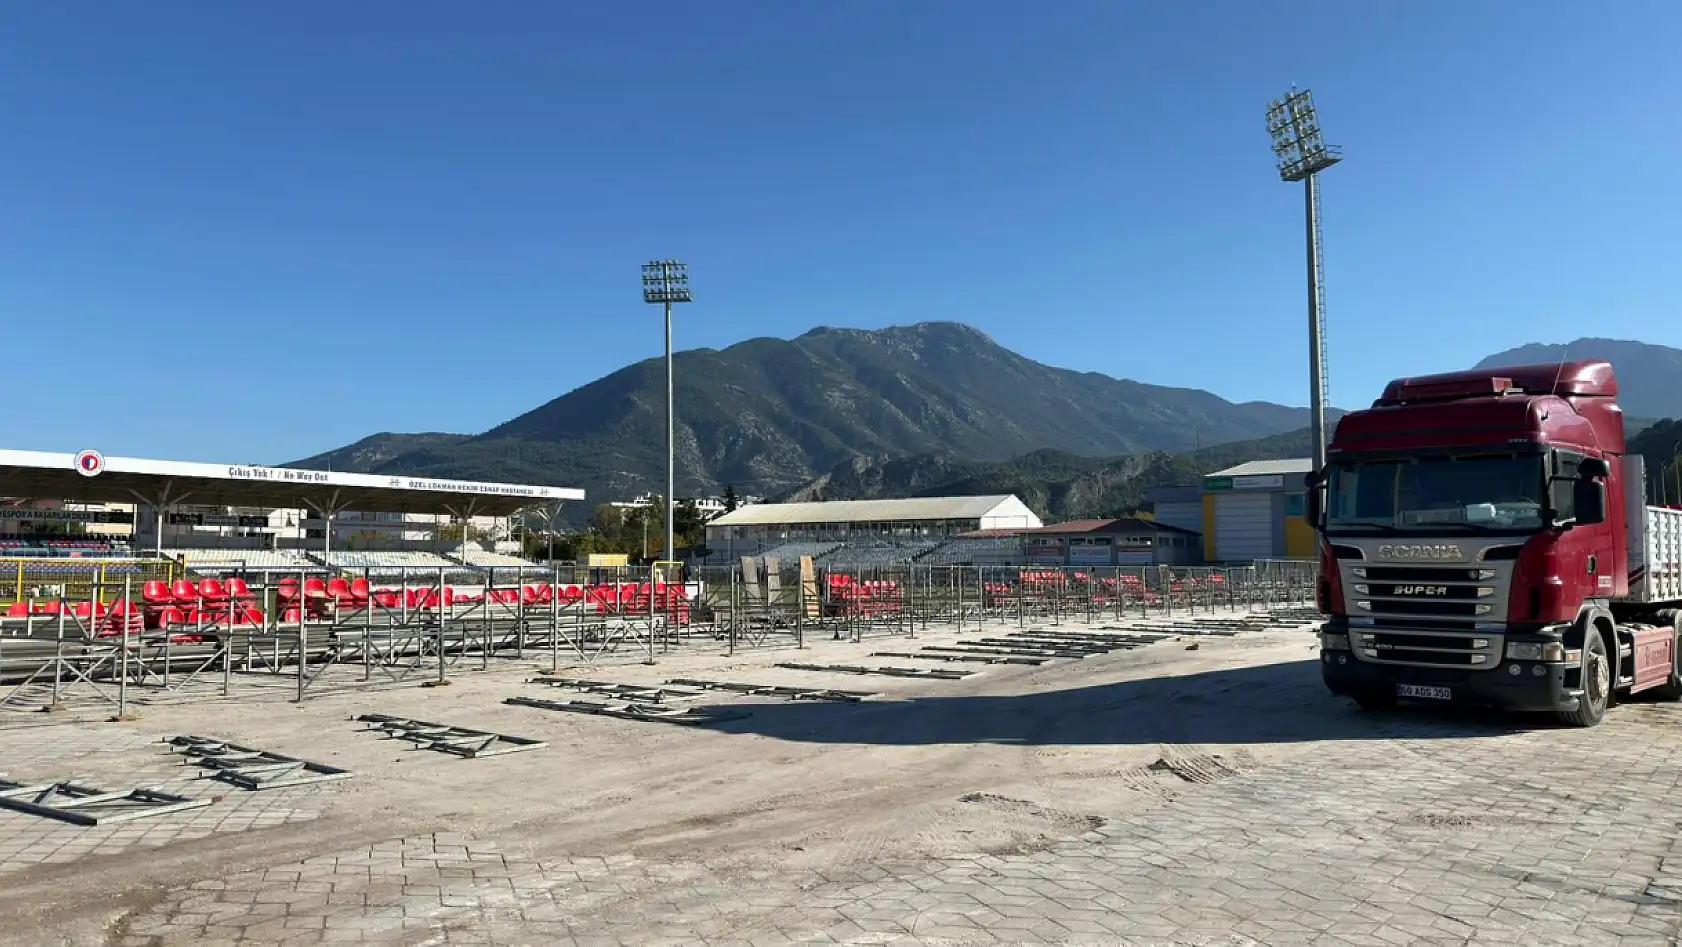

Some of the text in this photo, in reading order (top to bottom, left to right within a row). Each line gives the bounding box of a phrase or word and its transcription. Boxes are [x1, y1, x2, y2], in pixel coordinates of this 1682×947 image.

[253, 468, 268, 478] Yok
[284, 471, 294, 480] No
[297, 472, 312, 482] Way
[1379, 544, 1462, 559] SCANIA
[1394, 585, 1447, 595] SUPER
[1434, 688, 1450, 698] 350
